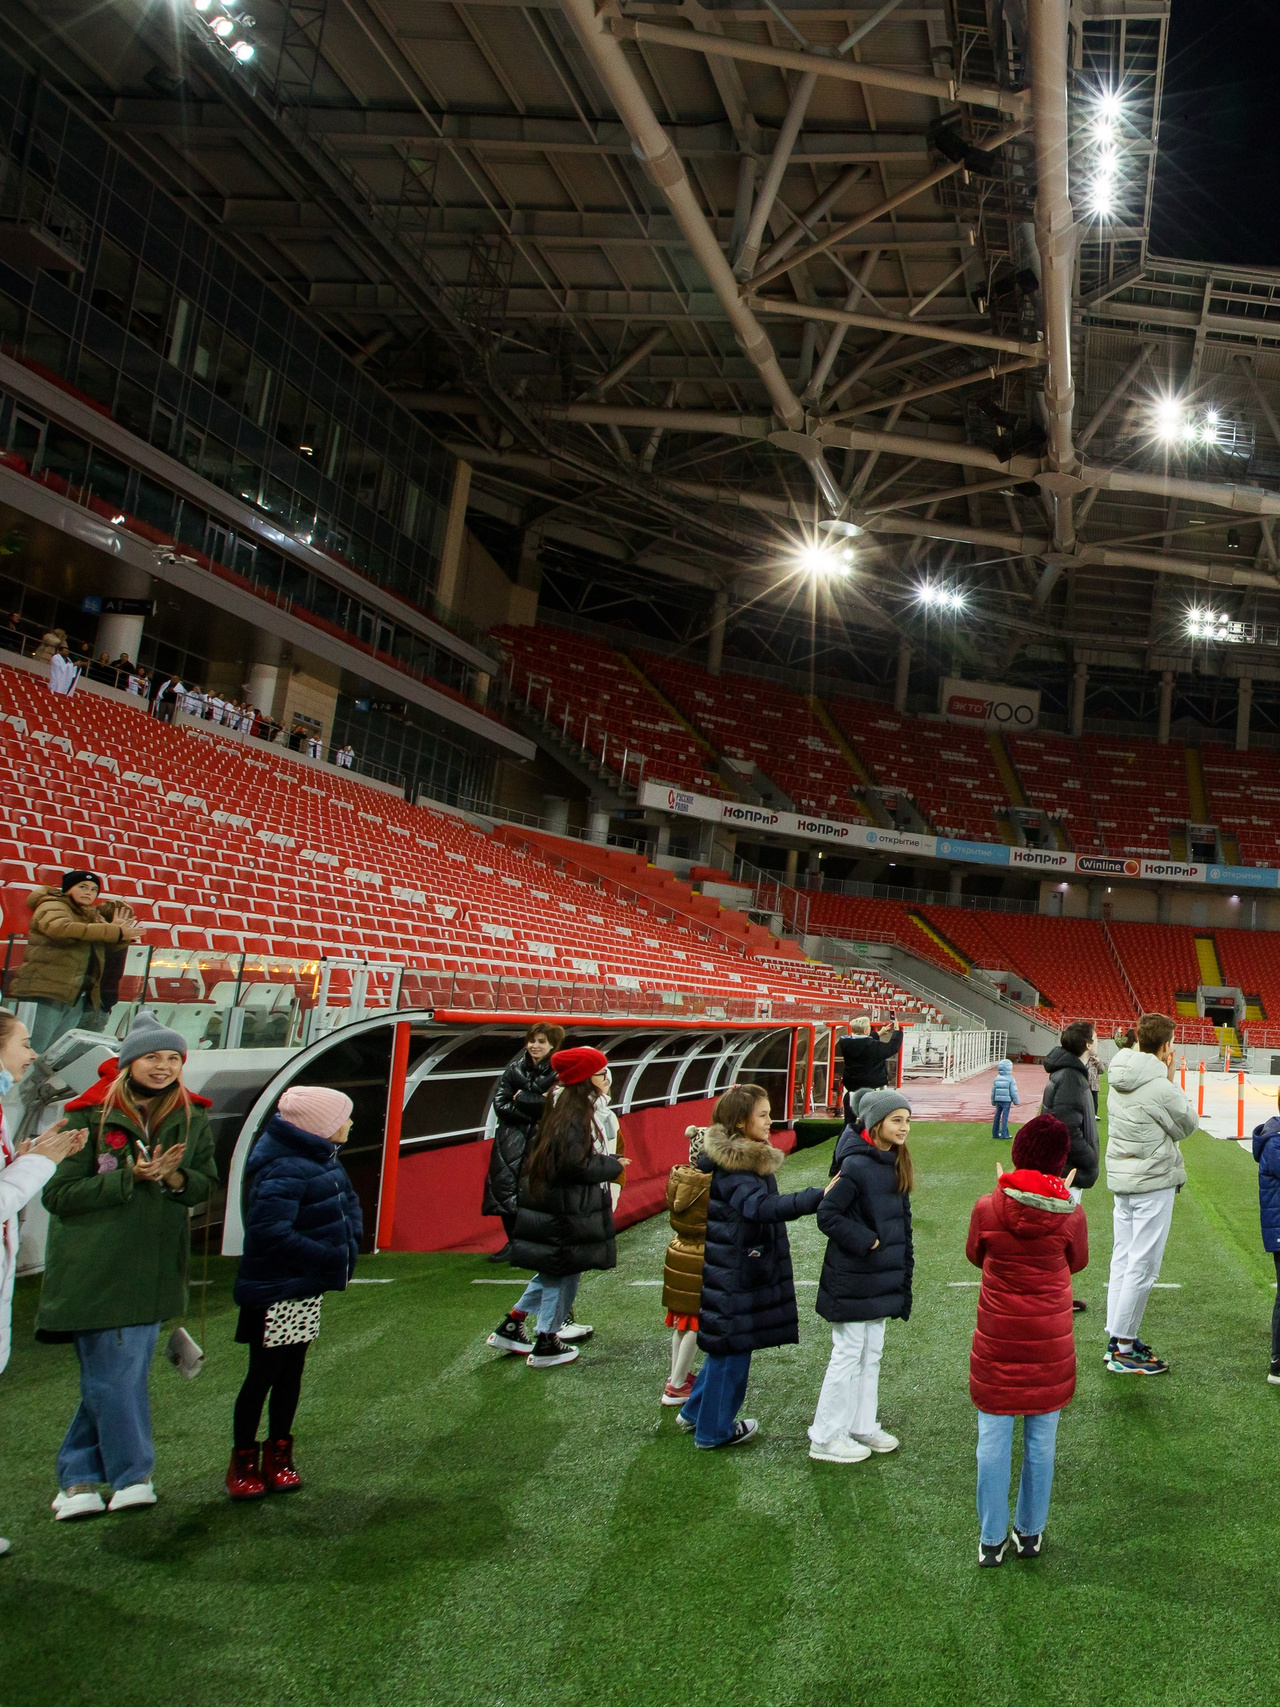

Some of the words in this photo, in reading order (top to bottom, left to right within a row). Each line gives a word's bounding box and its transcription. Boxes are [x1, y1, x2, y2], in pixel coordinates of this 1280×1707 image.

[952, 701, 983, 713] ЭКТО
[986, 701, 1034, 724] 100
[675, 801, 689, 813] РАДИО
[879, 835, 920, 847] открытие
[952, 846, 992, 857] открытие
[1082, 859, 1121, 871] Winline
